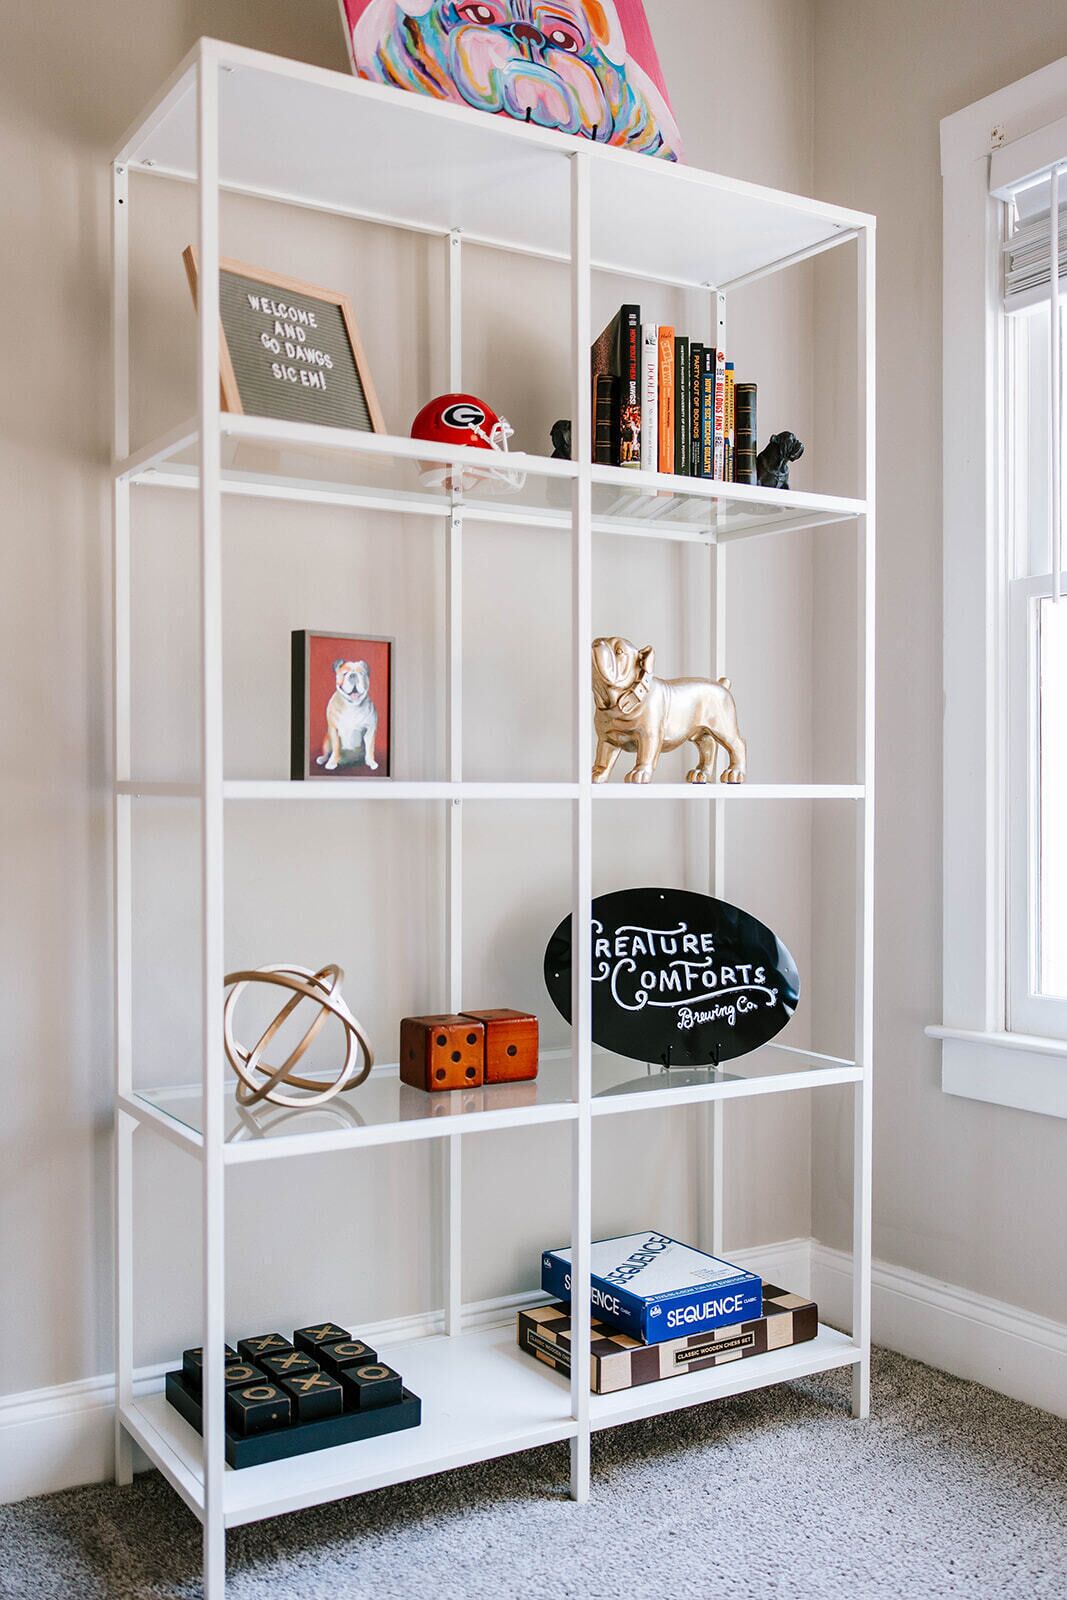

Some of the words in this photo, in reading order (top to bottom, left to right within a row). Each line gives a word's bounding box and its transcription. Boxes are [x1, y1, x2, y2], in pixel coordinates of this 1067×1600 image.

[248, 294, 317, 328] WELCOME
[274, 321, 305, 342] AND
[629, 328, 637, 344] HOW
[261, 333, 280, 354] GO
[285, 342, 333, 369] DAWGS
[272, 363, 297, 382] SIC
[629, 363, 637, 380] THEM
[647, 363, 655, 402] DOOLEY
[693, 396, 700, 407] OF
[715, 415, 723, 431] FANS
[678, 1007, 735, 1030] Brewing
[603, 1236, 672, 1285] SEQUENCE
[564, 1274, 620, 1316] SENCE
[667, 1294, 744, 1328] SEQUENCE
[677, 1350, 700, 1361] CLASSIC
[701, 1343, 723, 1354] WOODEN
[724, 1338, 741, 1349] CHESS
[741, 1335, 752, 1345] SET
